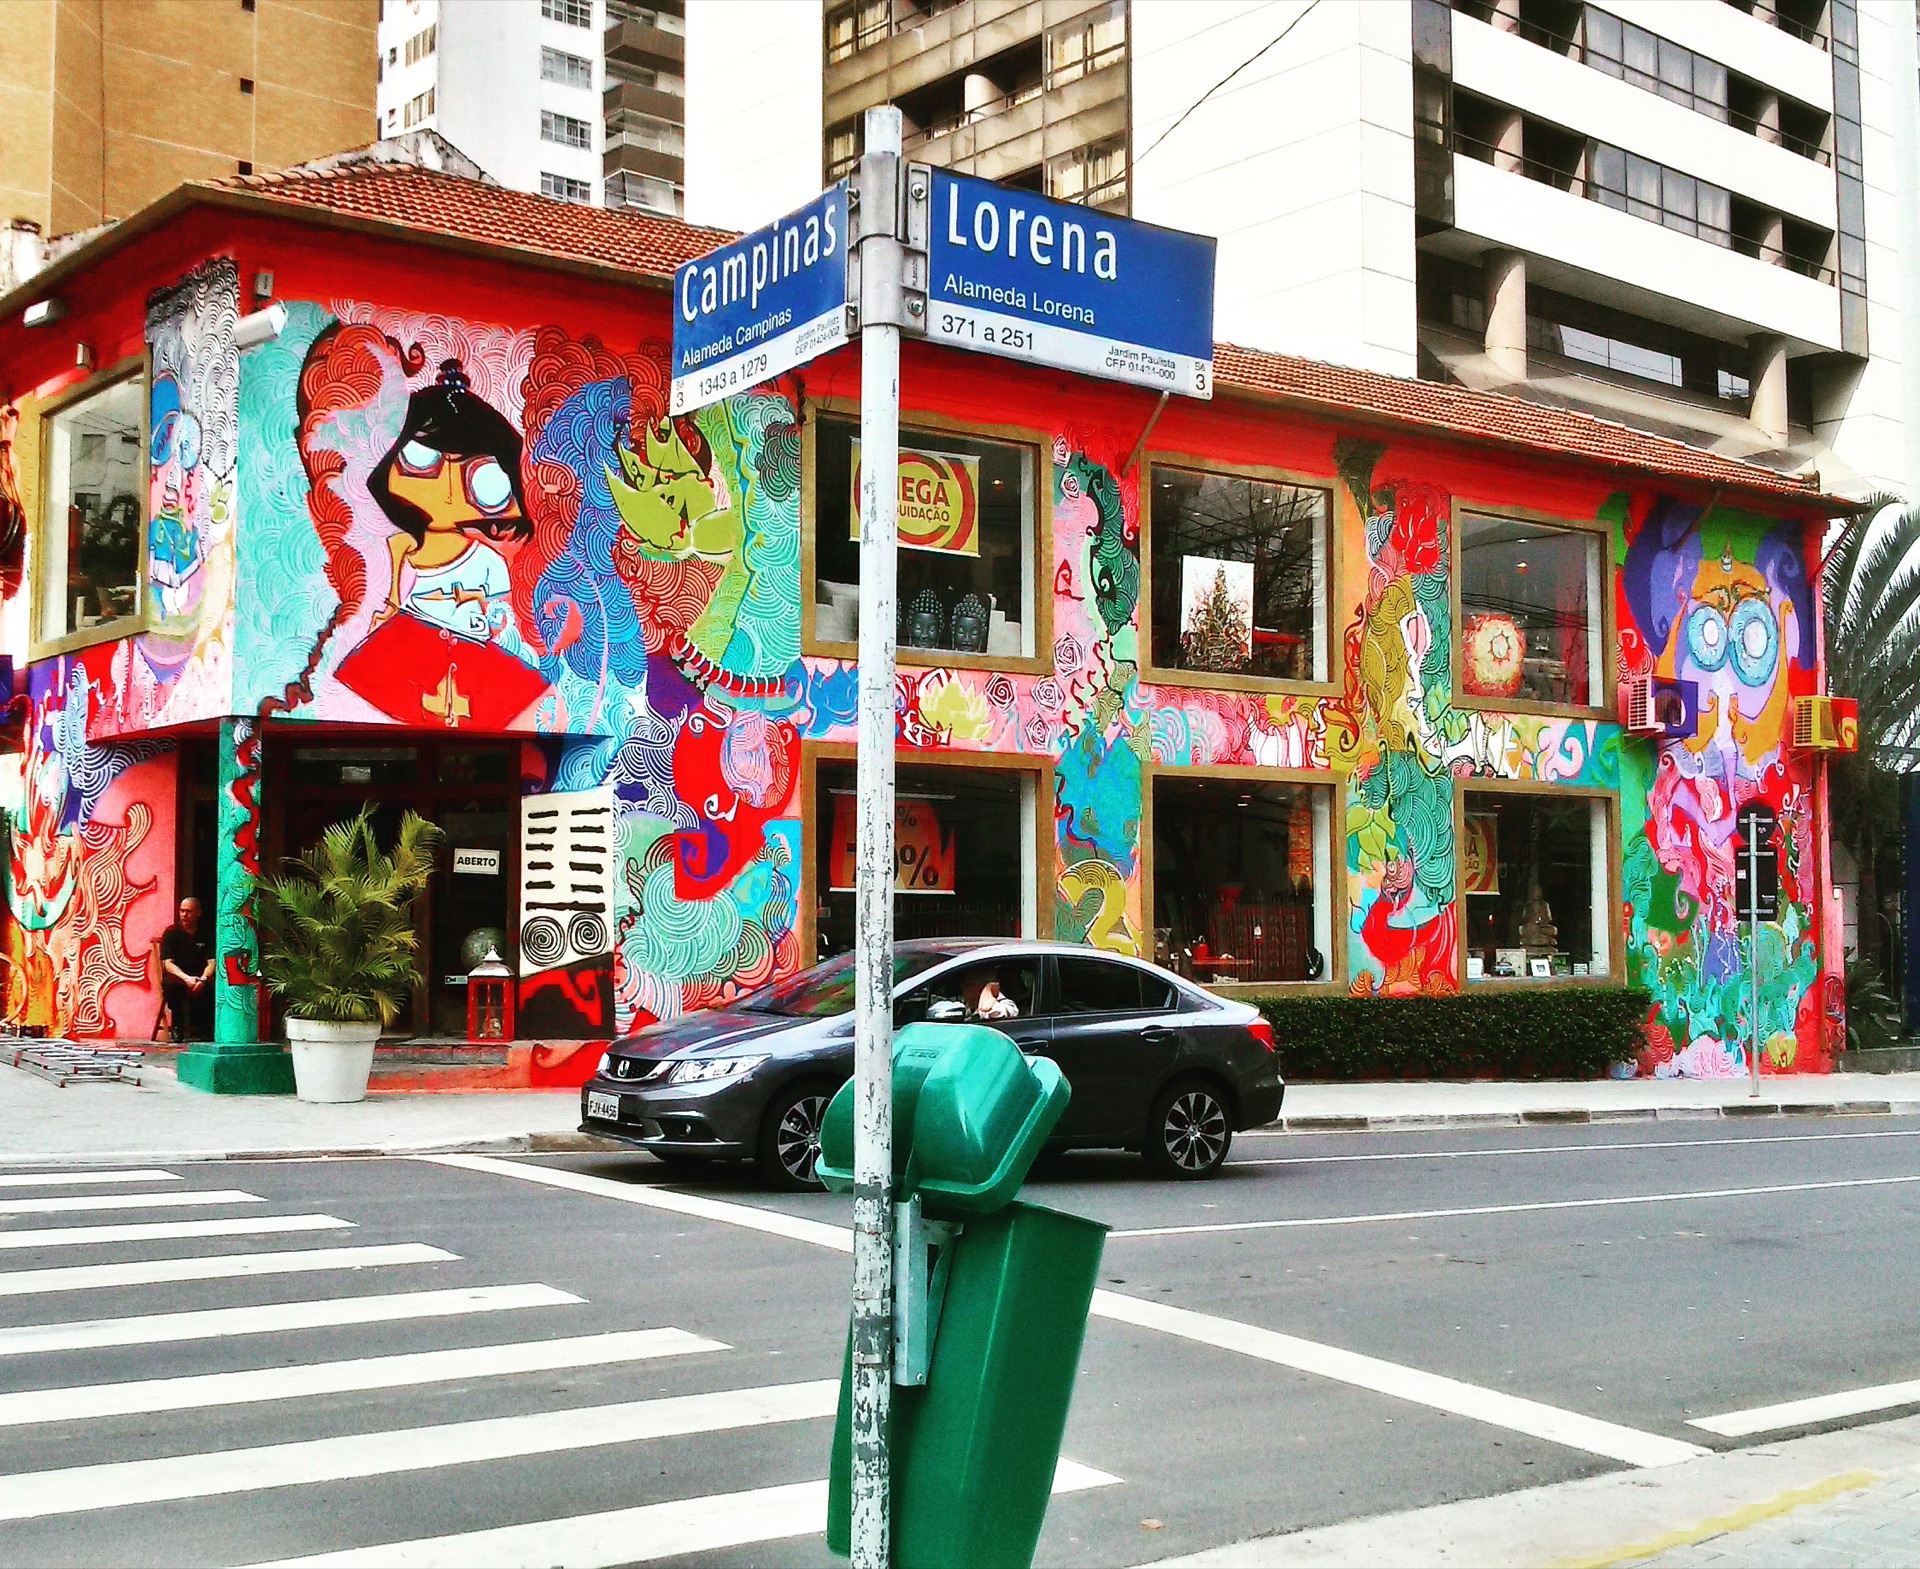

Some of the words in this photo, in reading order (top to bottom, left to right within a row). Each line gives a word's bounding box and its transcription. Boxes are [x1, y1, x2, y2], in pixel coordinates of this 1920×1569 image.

[948, 181, 1119, 281] Lorena
[681, 205, 837, 322] Campinas
[943, 273, 1027, 309] Alameda
[1033, 292, 1096, 325] Lorena
[682, 336, 733, 369] Alameda
[736, 308, 792, 346] Campinas
[942, 314, 976, 339] 371
[984, 325, 996, 343] a
[1001, 327, 1034, 350] 251
[1108, 346, 1139, 360] Jardim
[699, 372, 727, 397] 1343
[730, 371, 737, 386] a
[741, 354, 768, 380] 1279
[1195, 374, 1206, 391] 3
[676, 391, 684, 408] 3
[898, 475, 950, 507] EGA
[897, 505, 950, 523] UIDAÇÃO
[457, 856, 497, 867] ABERTO
